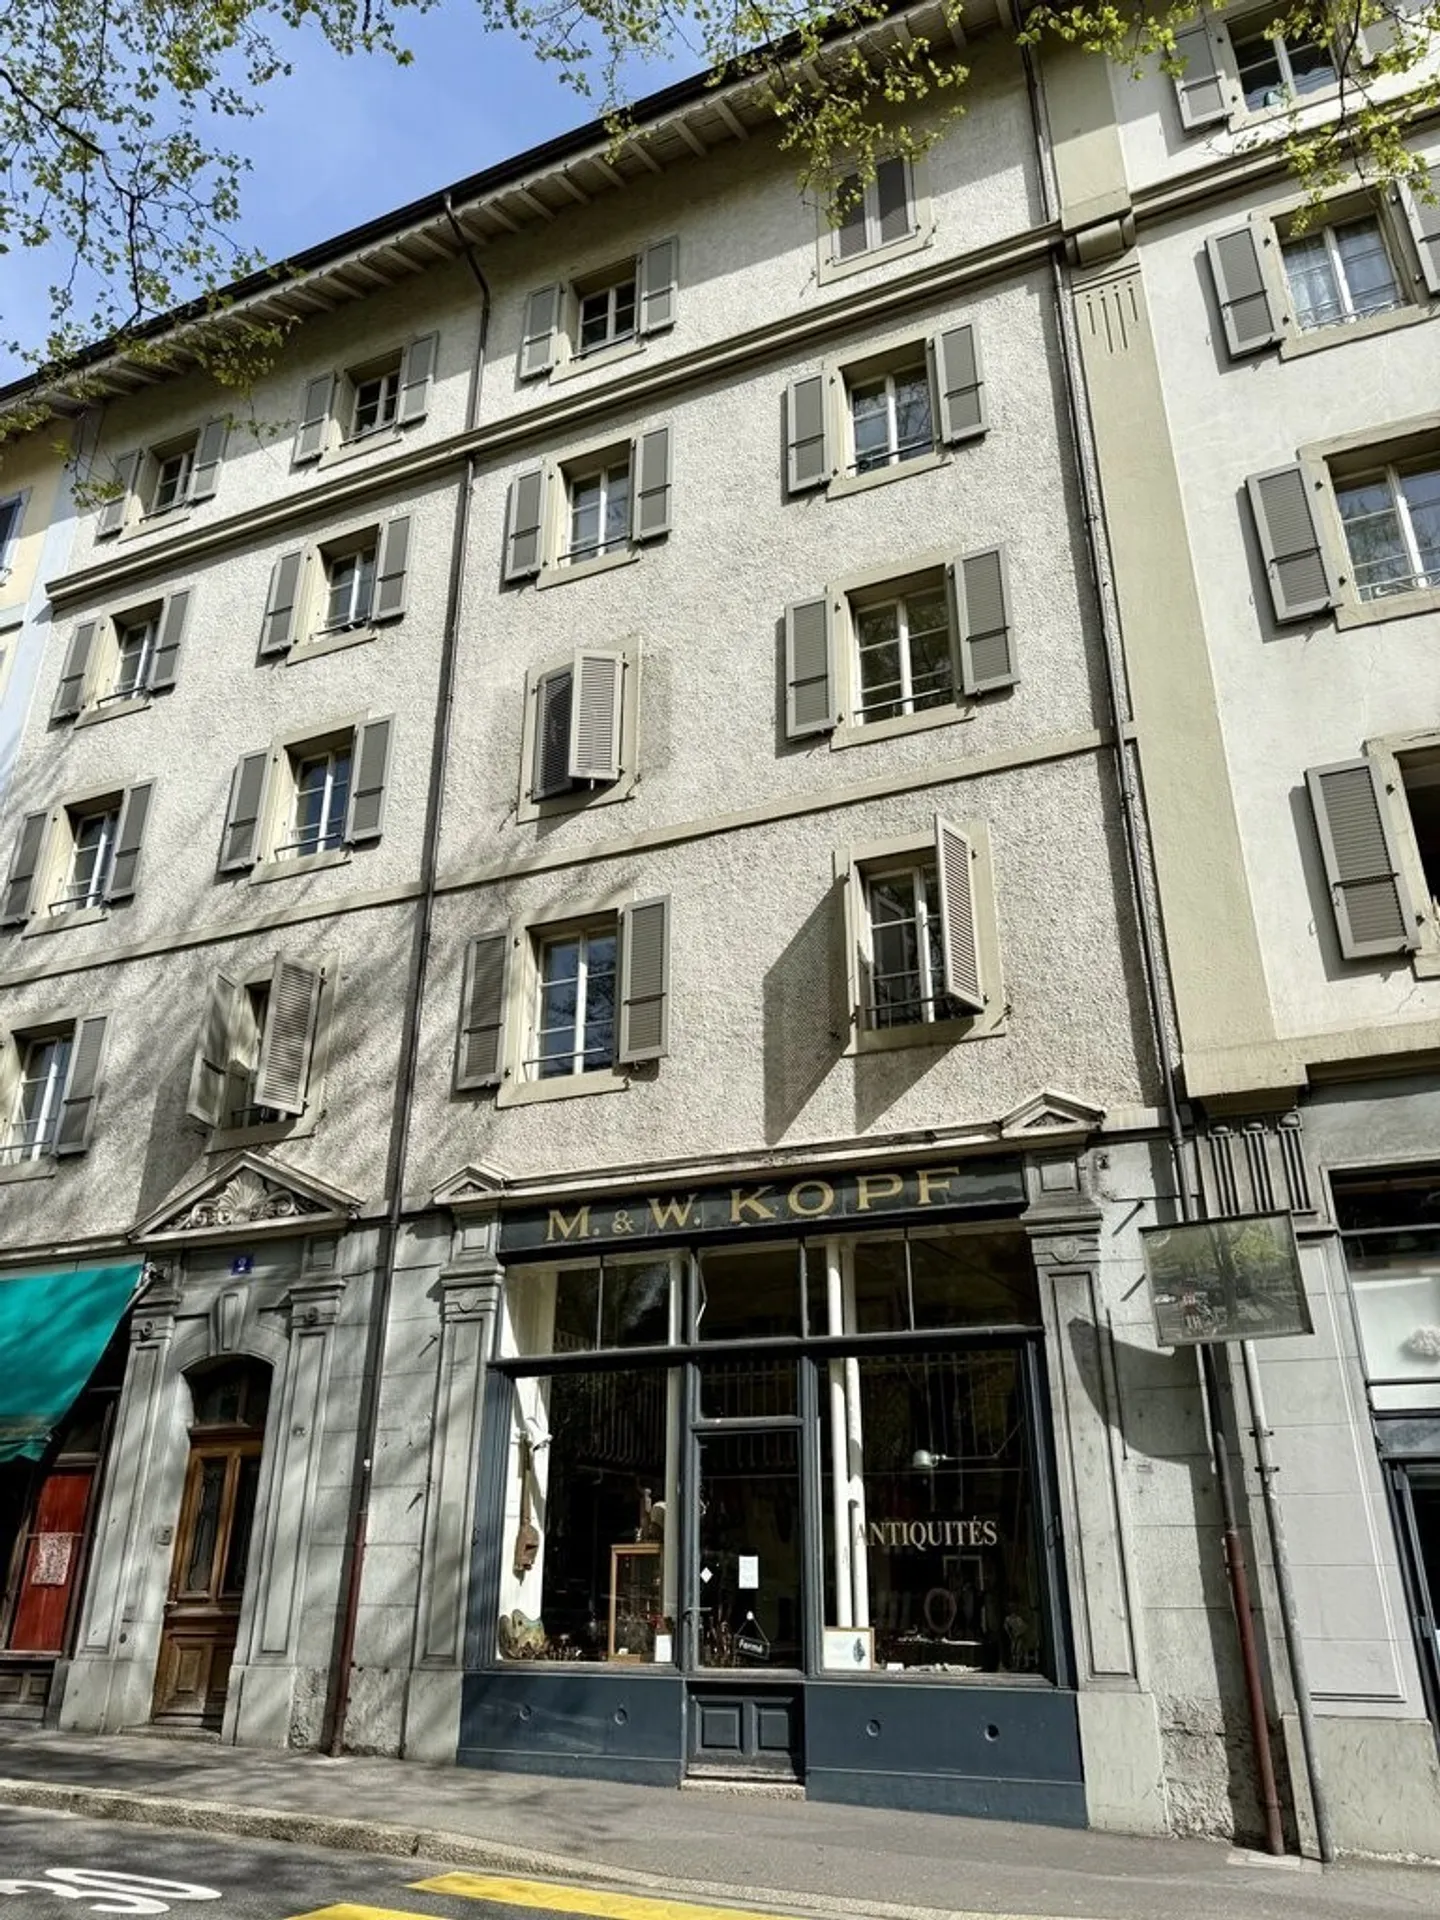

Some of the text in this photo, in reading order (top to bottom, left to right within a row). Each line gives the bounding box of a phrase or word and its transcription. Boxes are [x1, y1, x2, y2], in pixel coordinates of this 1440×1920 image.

[546, 1167, 960, 1240] M. & W. KOPF
[855, 1515, 998, 1551] ANTIQUITÉS
[0, 1868, 222, 1914] 30
